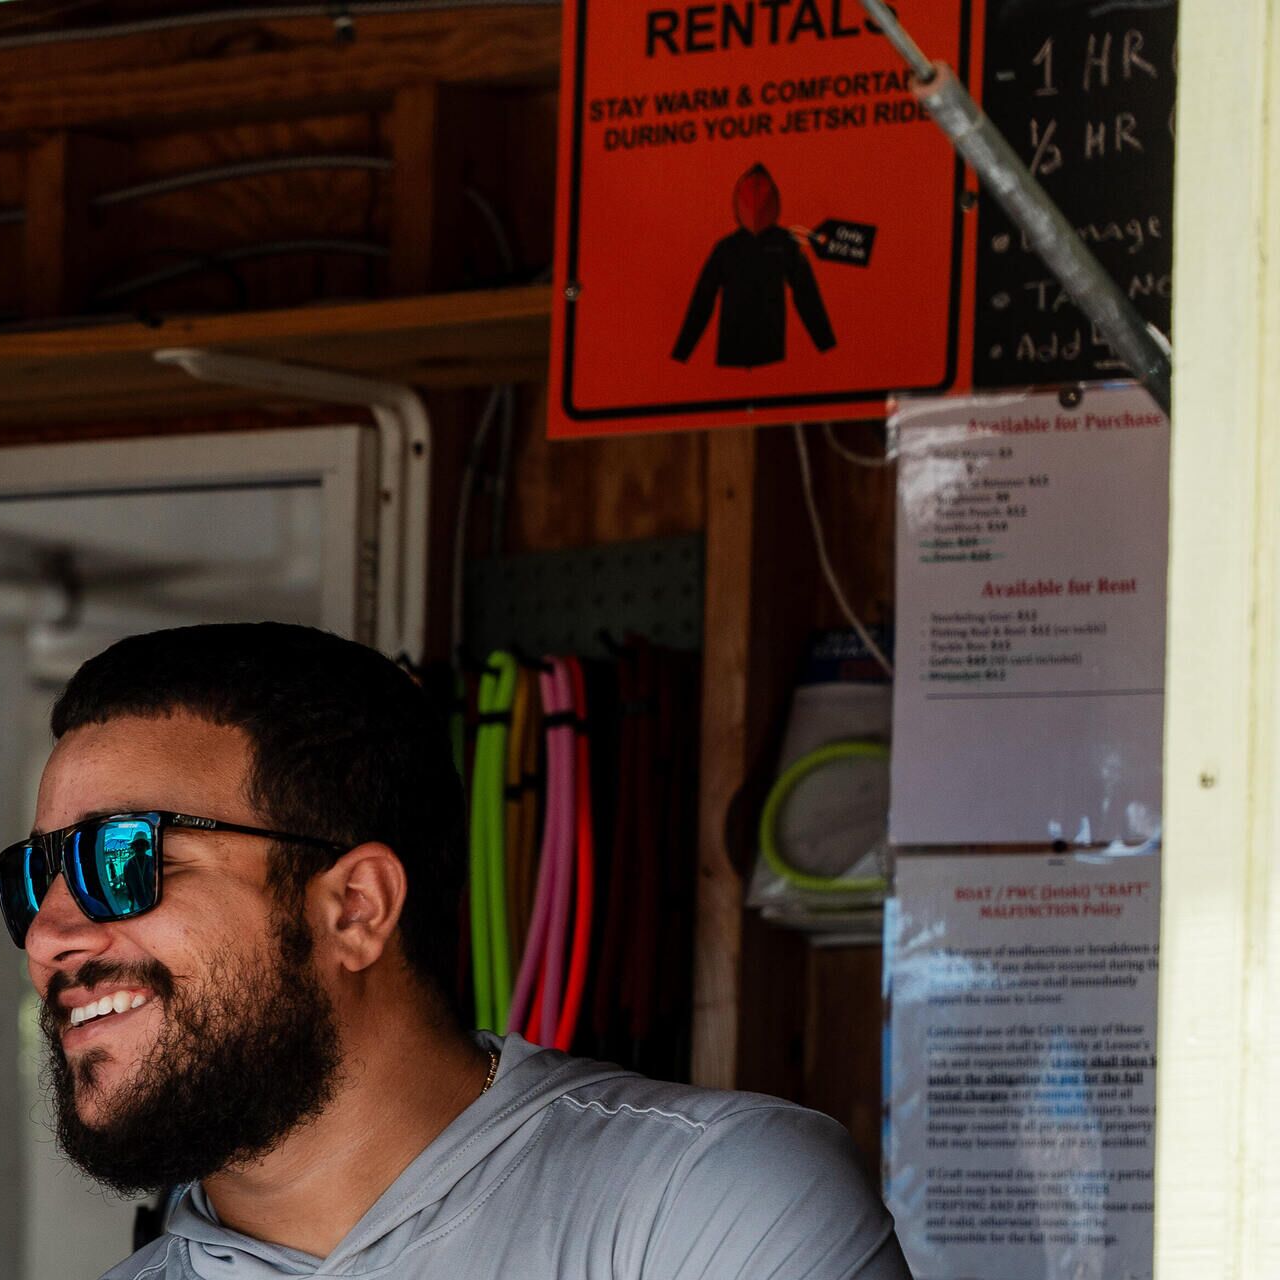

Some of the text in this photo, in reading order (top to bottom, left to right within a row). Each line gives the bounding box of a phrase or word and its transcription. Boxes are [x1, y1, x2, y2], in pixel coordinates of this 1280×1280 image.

[1082, 28, 1158, 91] HR
[590, 69, 912, 123] STAY WARM & COMFORTA
[603, 120, 697, 150] DURING
[703, 113, 773, 141] YOUR
[779, 105, 867, 134] JETSKI
[1084, 111, 1143, 159] HR
[1054, 414, 1080, 432] for
[1085, 411, 1162, 431] Purchase
[981, 577, 1137, 598] Available for Rent
